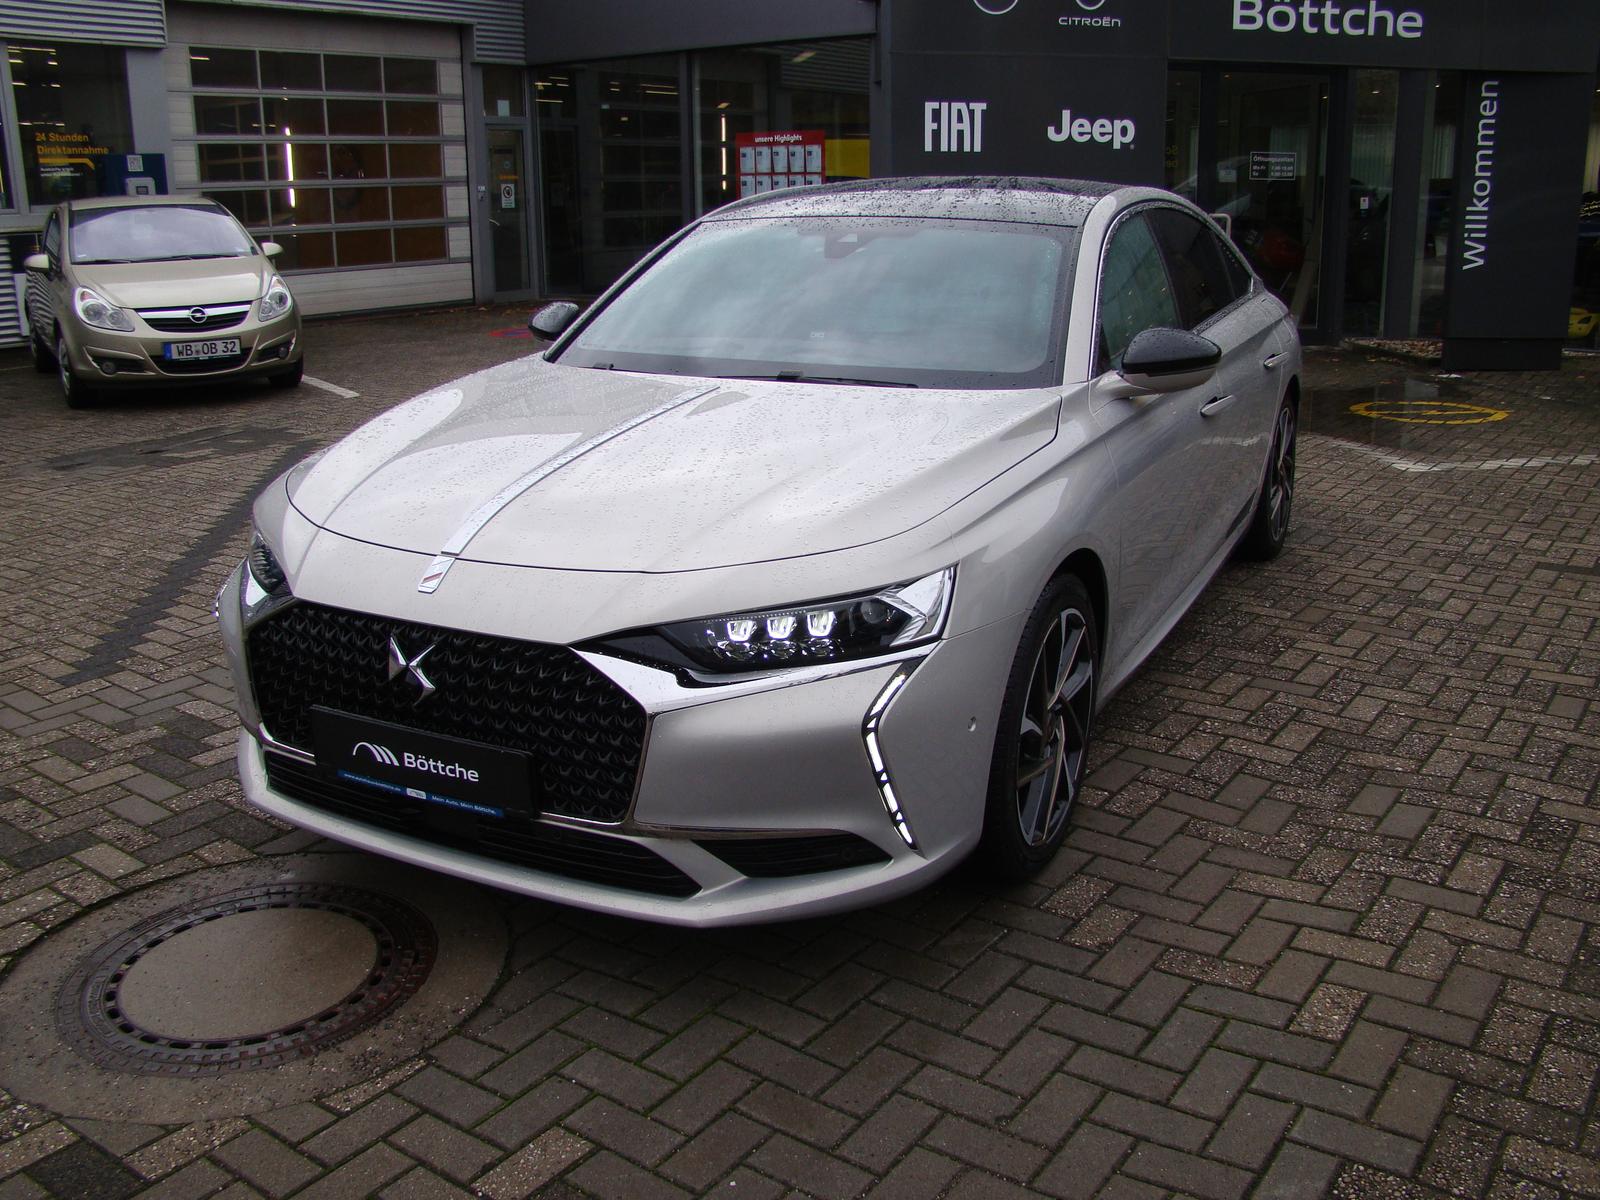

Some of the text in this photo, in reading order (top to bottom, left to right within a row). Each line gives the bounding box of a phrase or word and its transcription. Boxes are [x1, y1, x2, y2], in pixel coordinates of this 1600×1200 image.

[1058, 16, 1121, 27] CITROËN
[1232, 0, 1423, 38] Böttche
[34, 132, 89, 142] 24 Stunden
[924, 101, 987, 152] FIAT
[1047, 109, 1135, 150] Jeep
[36, 145, 110, 155] Direktannahme
[774, 134, 802, 143] Highlights
[1462, 80, 1499, 270] Willkommen
[176, 340, 237, 357] WB OB 32
[403, 752, 480, 782] Böttche
